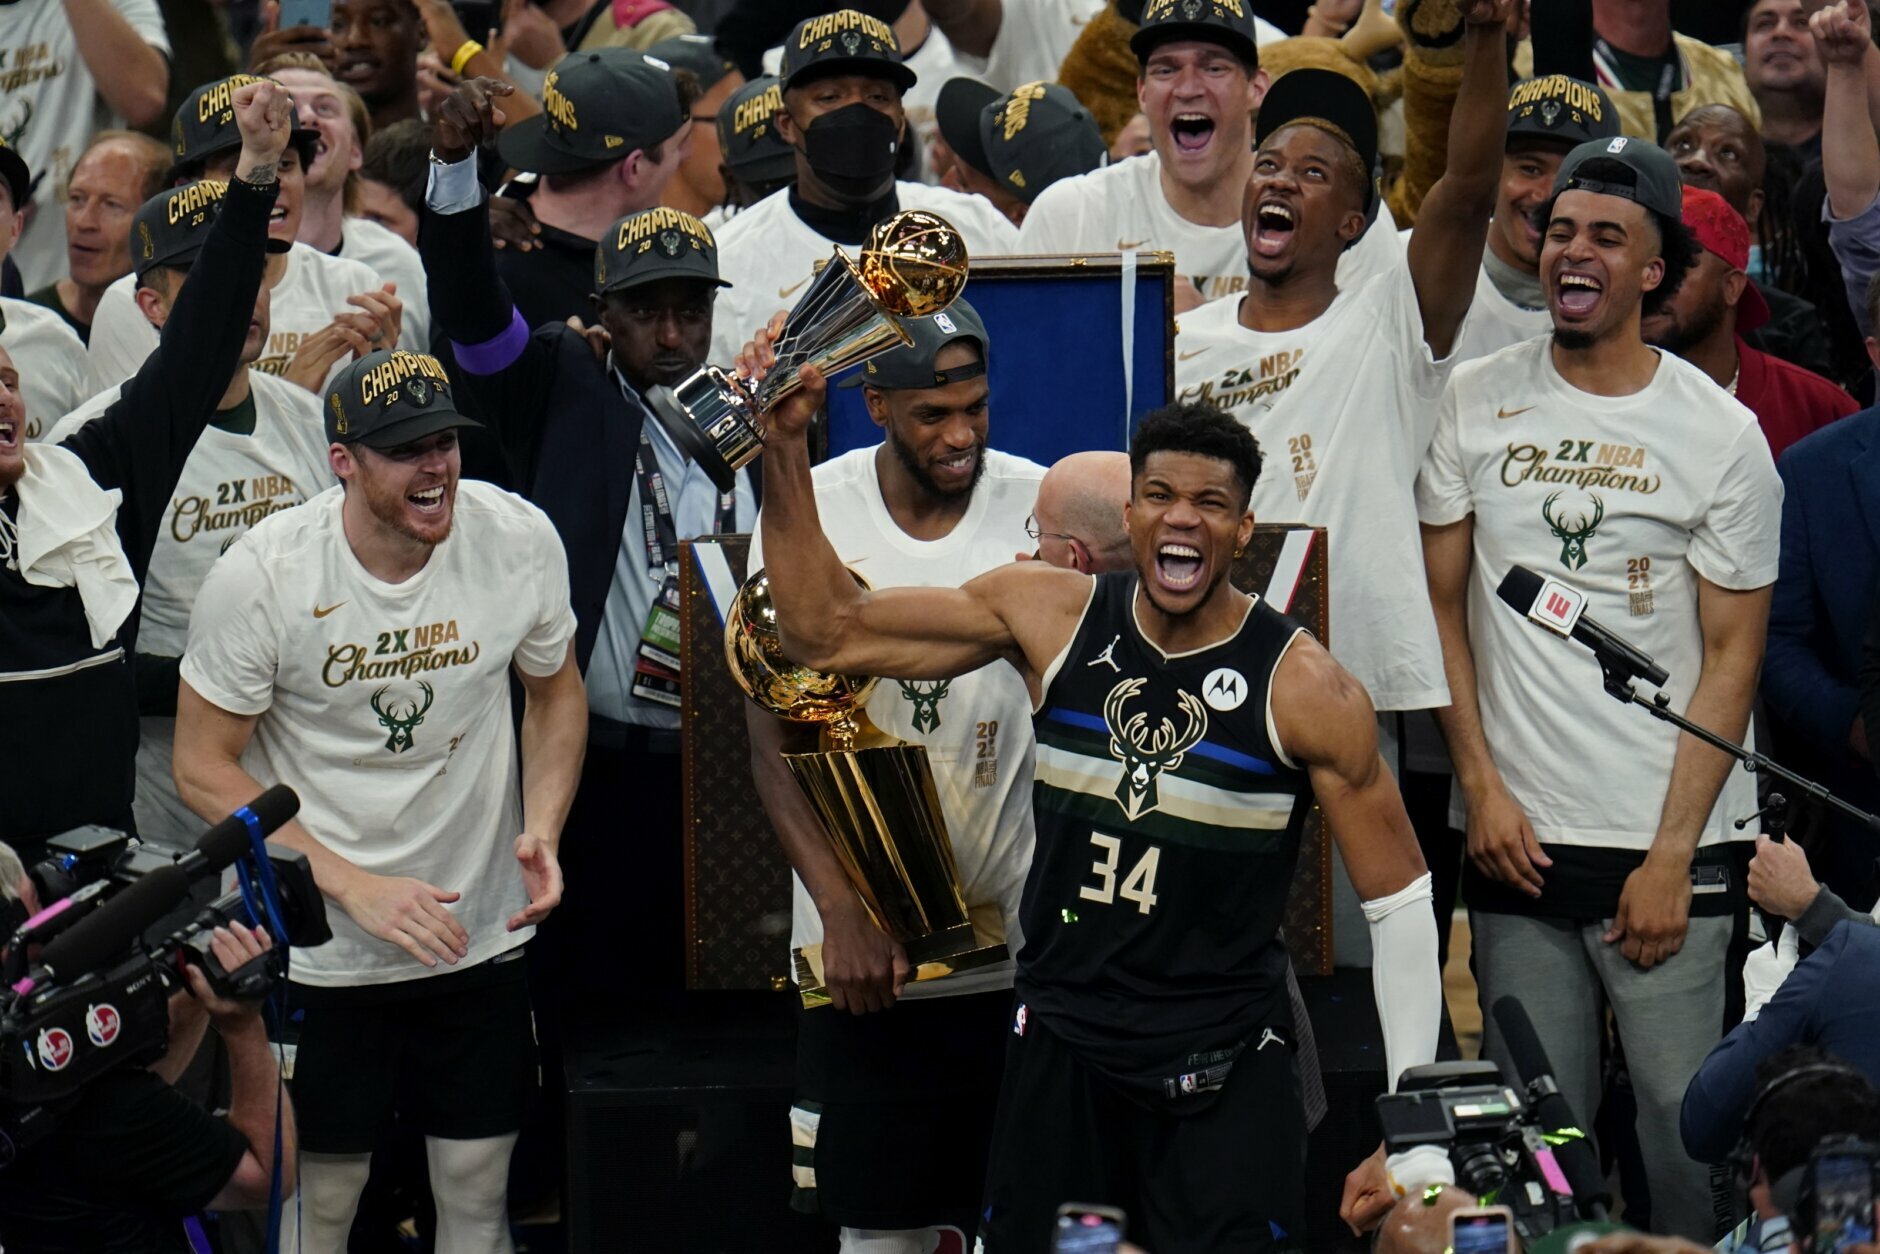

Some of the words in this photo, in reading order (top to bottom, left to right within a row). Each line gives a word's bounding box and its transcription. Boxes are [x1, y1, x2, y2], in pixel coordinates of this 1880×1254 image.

[799, 9, 896, 51] CHAMPIONS
[1508, 77, 1602, 122] CHAMPIONS
[221, 110, 233, 125] 20
[168, 180, 230, 226] CHAMP
[191, 212, 205, 226] 20
[618, 207, 713, 250] CHAMPIONS
[1212, 276, 1249, 296] NB
[386, 391, 399, 405] 20
[1288, 433, 1312, 455] 20
[1555, 439, 1595, 463] 2X
[1596, 443, 1645, 469] NBA
[1501, 442, 1661, 495] Champions
[217, 479, 247, 505] 2X
[252, 475, 294, 499] NBA
[1627, 556, 1650, 573] 20
[375, 628, 410, 655] 2X
[414, 619, 459, 648] NBA
[322, 640, 479, 688] Champions
[976, 720, 998, 738] 20
[1080, 831, 1160, 915] 34
[126, 974, 152, 994] SONY
